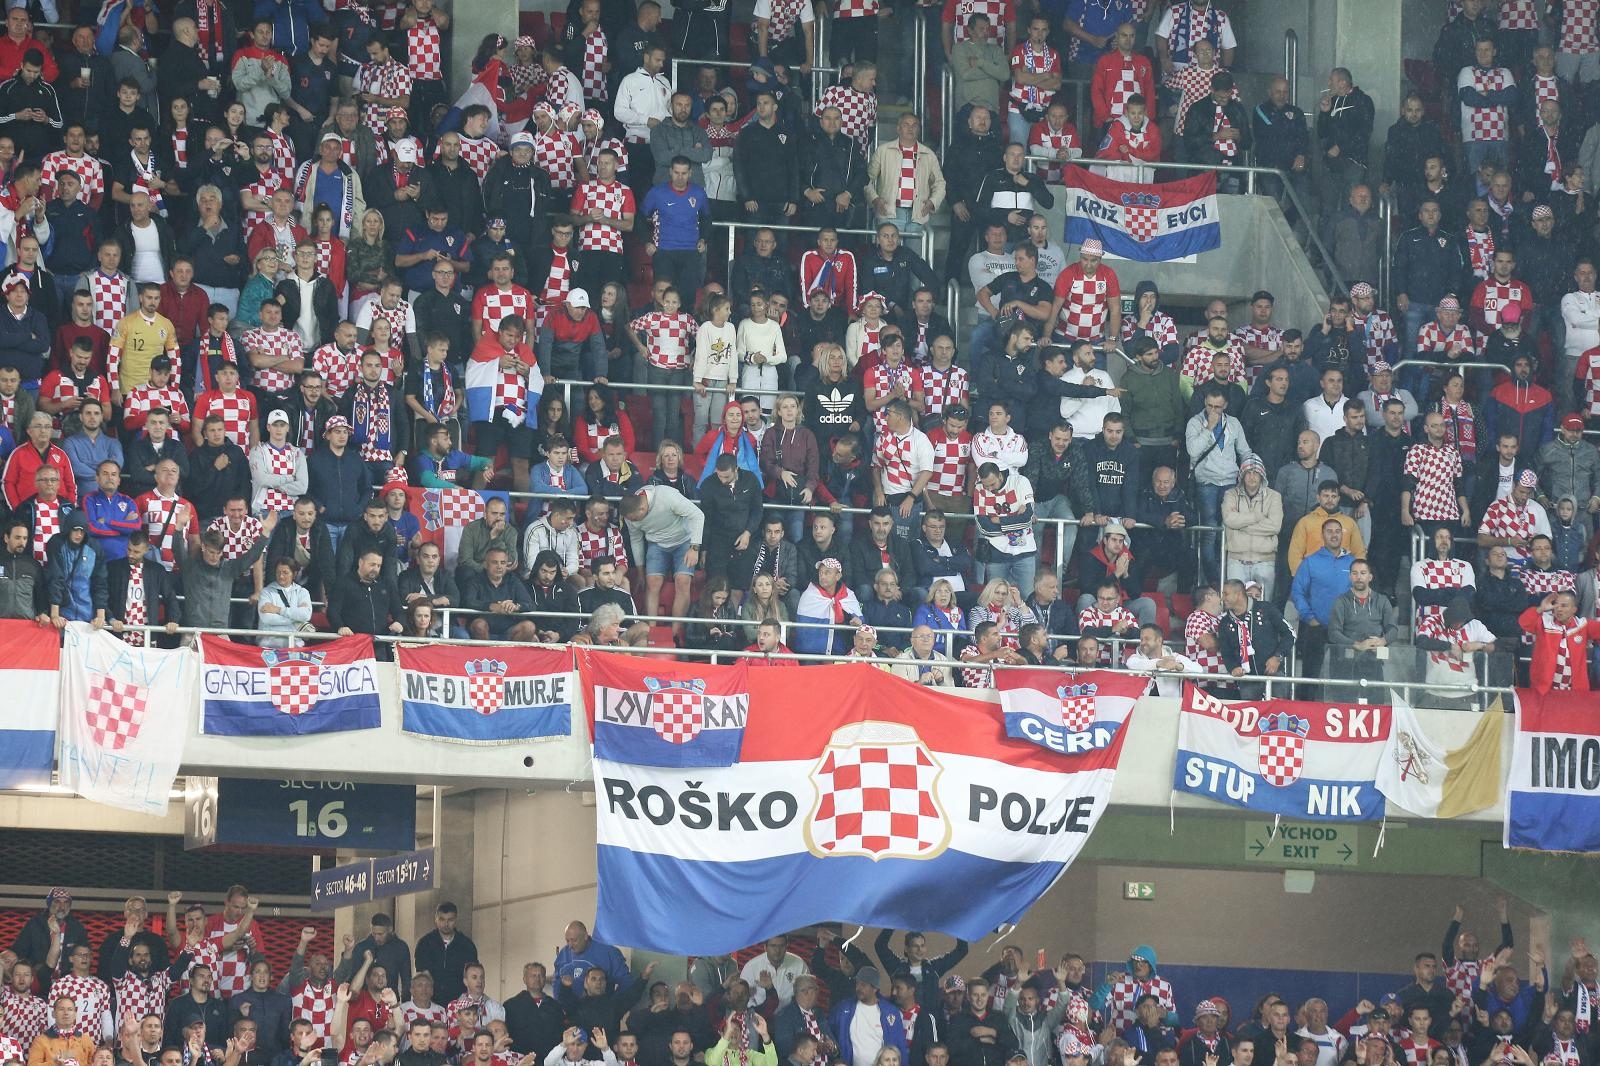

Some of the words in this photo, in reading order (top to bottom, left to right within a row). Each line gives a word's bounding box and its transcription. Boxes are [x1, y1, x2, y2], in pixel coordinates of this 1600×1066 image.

[961, 2, 974, 14] 50
[346, 27, 354, 39] 7
[1076, 196, 1118, 223] KRIŽ
[1167, 204, 1207, 228] EVCI
[1485, 299, 1497, 310] 20
[133, 338, 145, 351] 12
[820, 413, 852, 424] adidas
[148, 512, 162, 522] 17
[130, 588, 143, 600] 10
[205, 668, 266, 696] GARE
[319, 666, 376, 696] ŠNICA
[504, 677, 565, 706] MURJE
[602, 688, 653, 726] LOV
[703, 694, 748, 728] RAN
[1324, 708, 1381, 738] SKI
[1531, 737, 1600, 790] IMO
[1185, 757, 1255, 803] STUP
[1307, 784, 1362, 816] NIK
[602, 777, 798, 832] ROŠKO
[968, 783, 1095, 836] POLJE
[192, 798, 210, 838] 16
[288, 800, 348, 838] 16
[1266, 823, 1337, 841] VÝCHOD
[1283, 845, 1319, 858] EXIT
[326, 879, 344, 896] SECTOR
[344, 871, 367, 895] 46-48
[377, 868, 395, 885] SECTOR
[82, 1000, 89, 1013] 2
